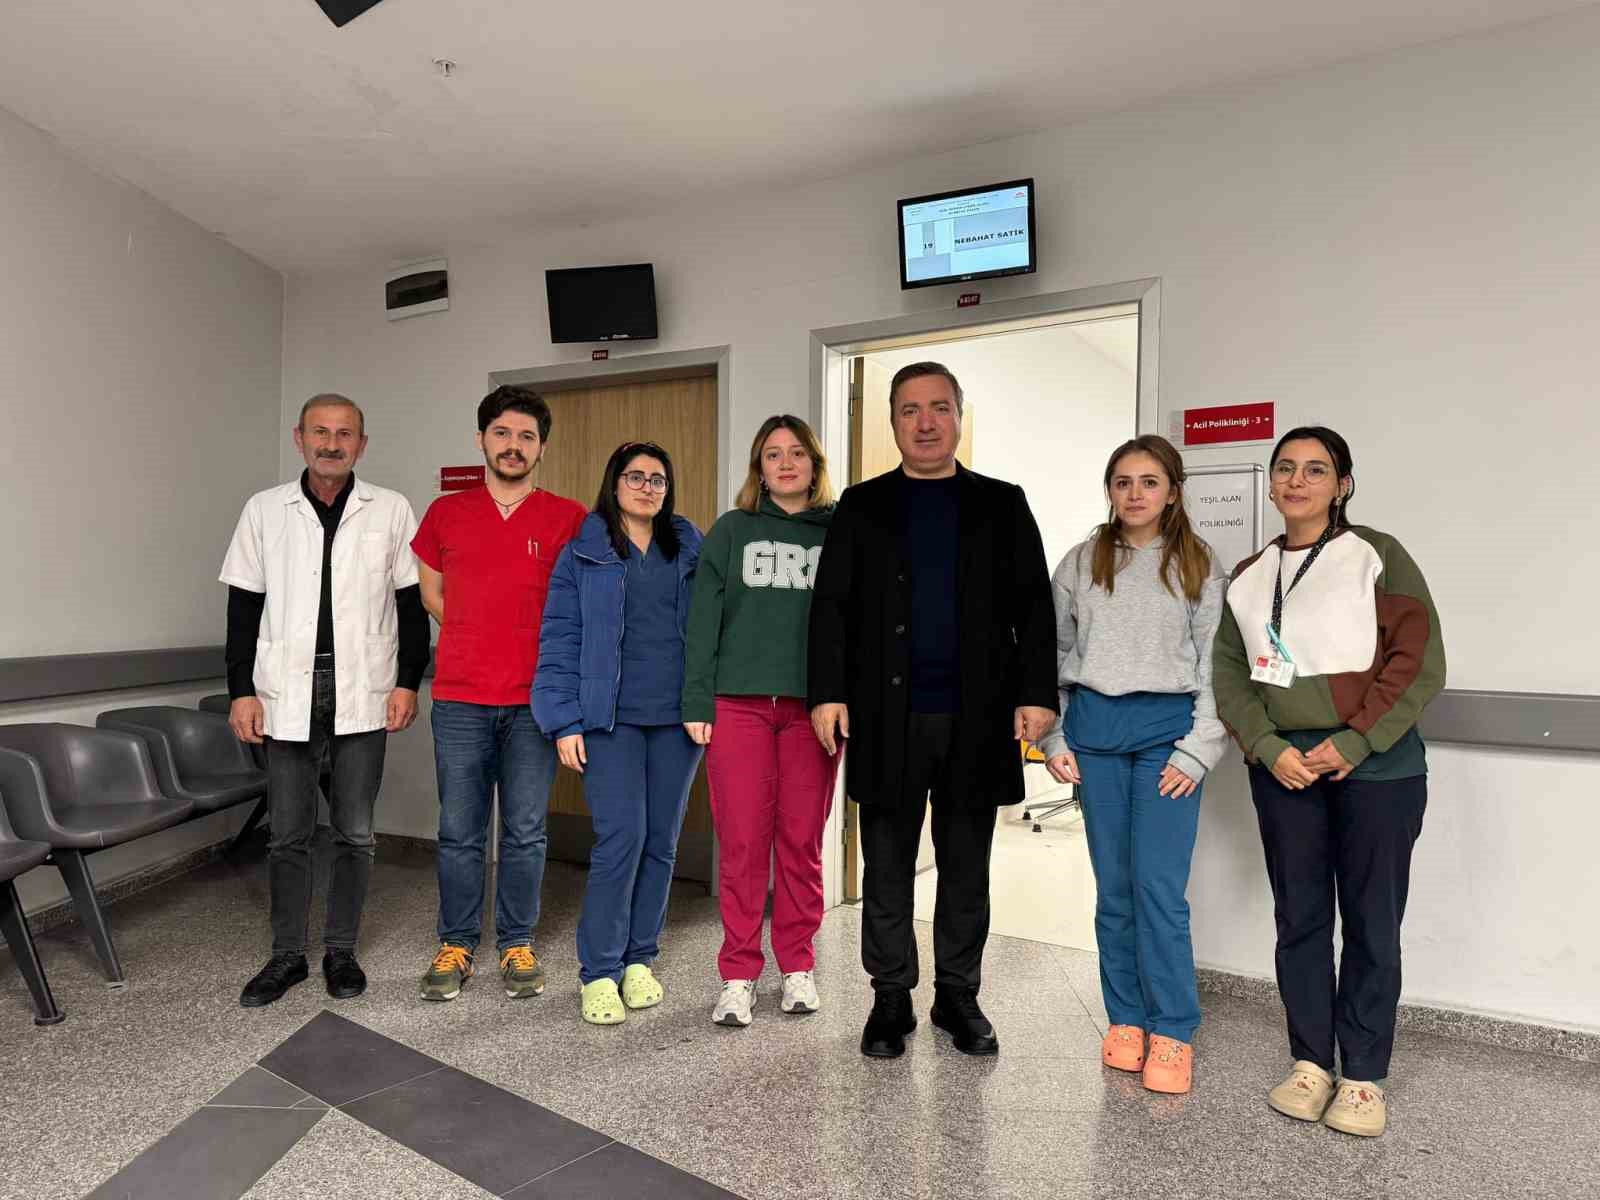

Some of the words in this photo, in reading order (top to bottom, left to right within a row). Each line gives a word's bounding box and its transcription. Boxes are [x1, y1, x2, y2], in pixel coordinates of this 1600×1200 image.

[954, 233, 994, 245] NEBAHAT
[1193, 420, 1207, 429] Acil
[1208, 417, 1249, 428] Polikliniği
[1255, 416, 1261, 424] 3
[1221, 495, 1241, 503] ALAN
